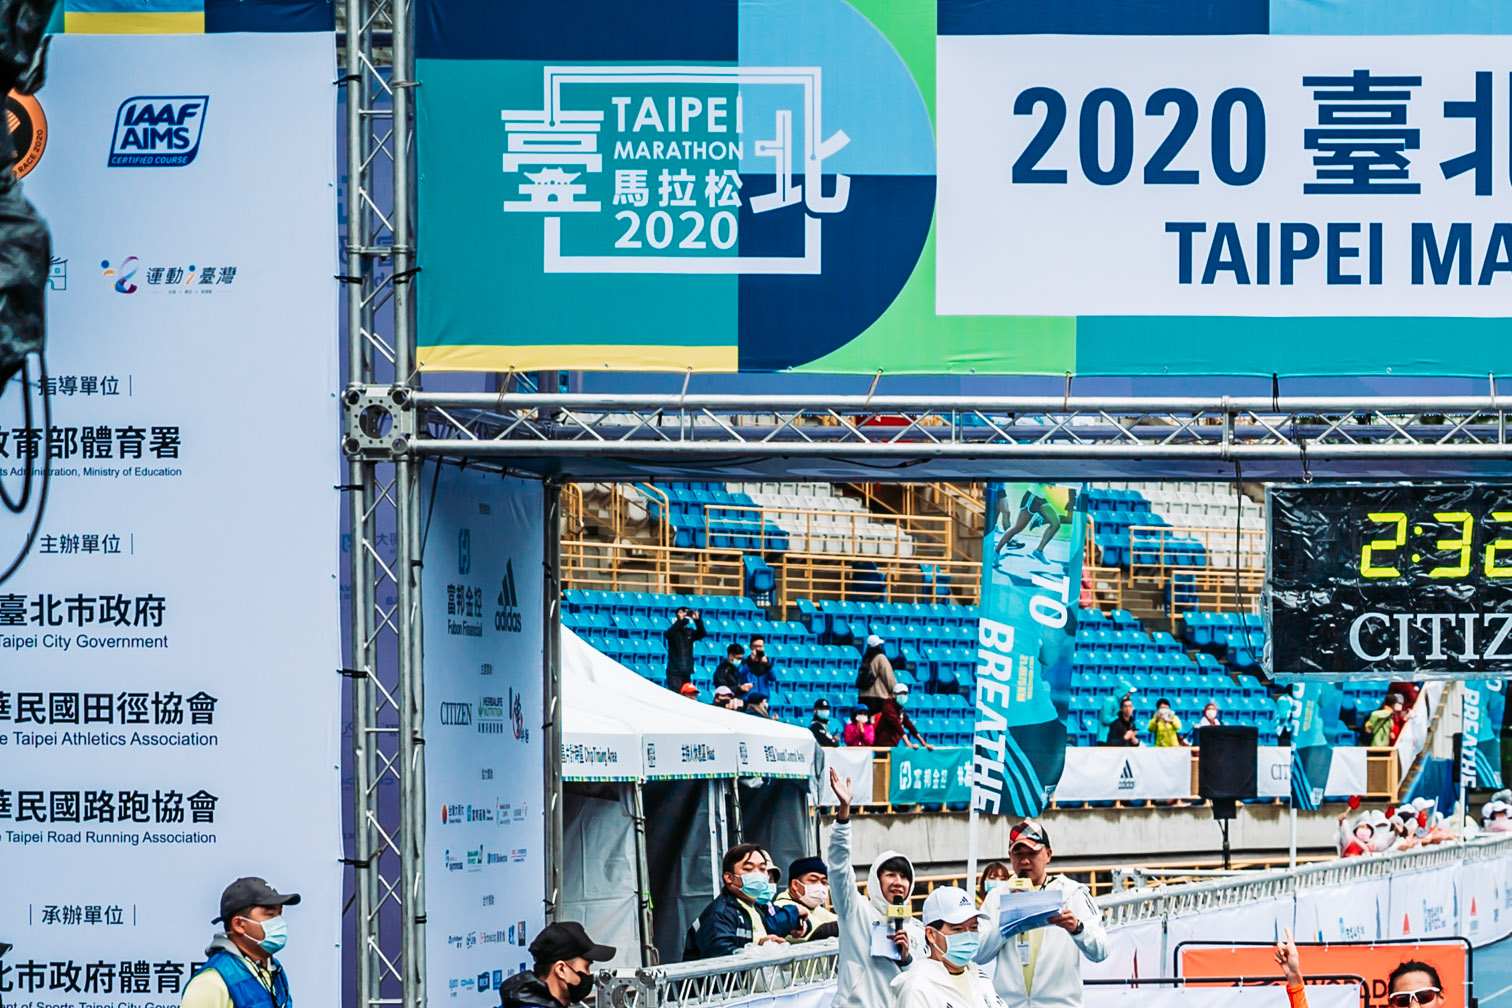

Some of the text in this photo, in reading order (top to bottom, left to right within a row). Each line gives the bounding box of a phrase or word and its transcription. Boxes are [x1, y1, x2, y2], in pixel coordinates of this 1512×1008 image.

[123, 103, 201, 126] IAAF
[612, 96, 744, 133] TAIPEI
[120, 127, 190, 150] AIMS
[1010, 86, 1268, 186] 2020
[18, 129, 44, 174] RACE 2020
[111, 156, 188, 164] CERTIFIED COURSE
[614, 141, 744, 160] MARATHON
[613, 169, 743, 208] 馬拉松
[614, 211, 738, 249] 2020
[1165, 222, 1383, 286] TAIPEI
[38, 375, 120, 396] 指導單位
[83, 467, 119, 478] Ministry
[122, 467, 132, 476] of
[135, 467, 182, 476] Education
[39, 534, 121, 554] 主辦單位
[0, 593, 166, 627] 臺北市政府
[1029, 574, 1070, 629] TO
[495, 605, 521, 632] adidas
[42, 635, 72, 651] City
[76, 635, 168, 649] Government
[440, 701, 472, 725] CITIZEN
[974, 617, 1015, 815] BREATHE
[13, 731, 218, 747] Taipei Athletics Association
[1462, 689, 1480, 788] BREATHE
[5, 831, 217, 846] Taipei Road Running Association
[41, 905, 124, 925] 承辦單位
